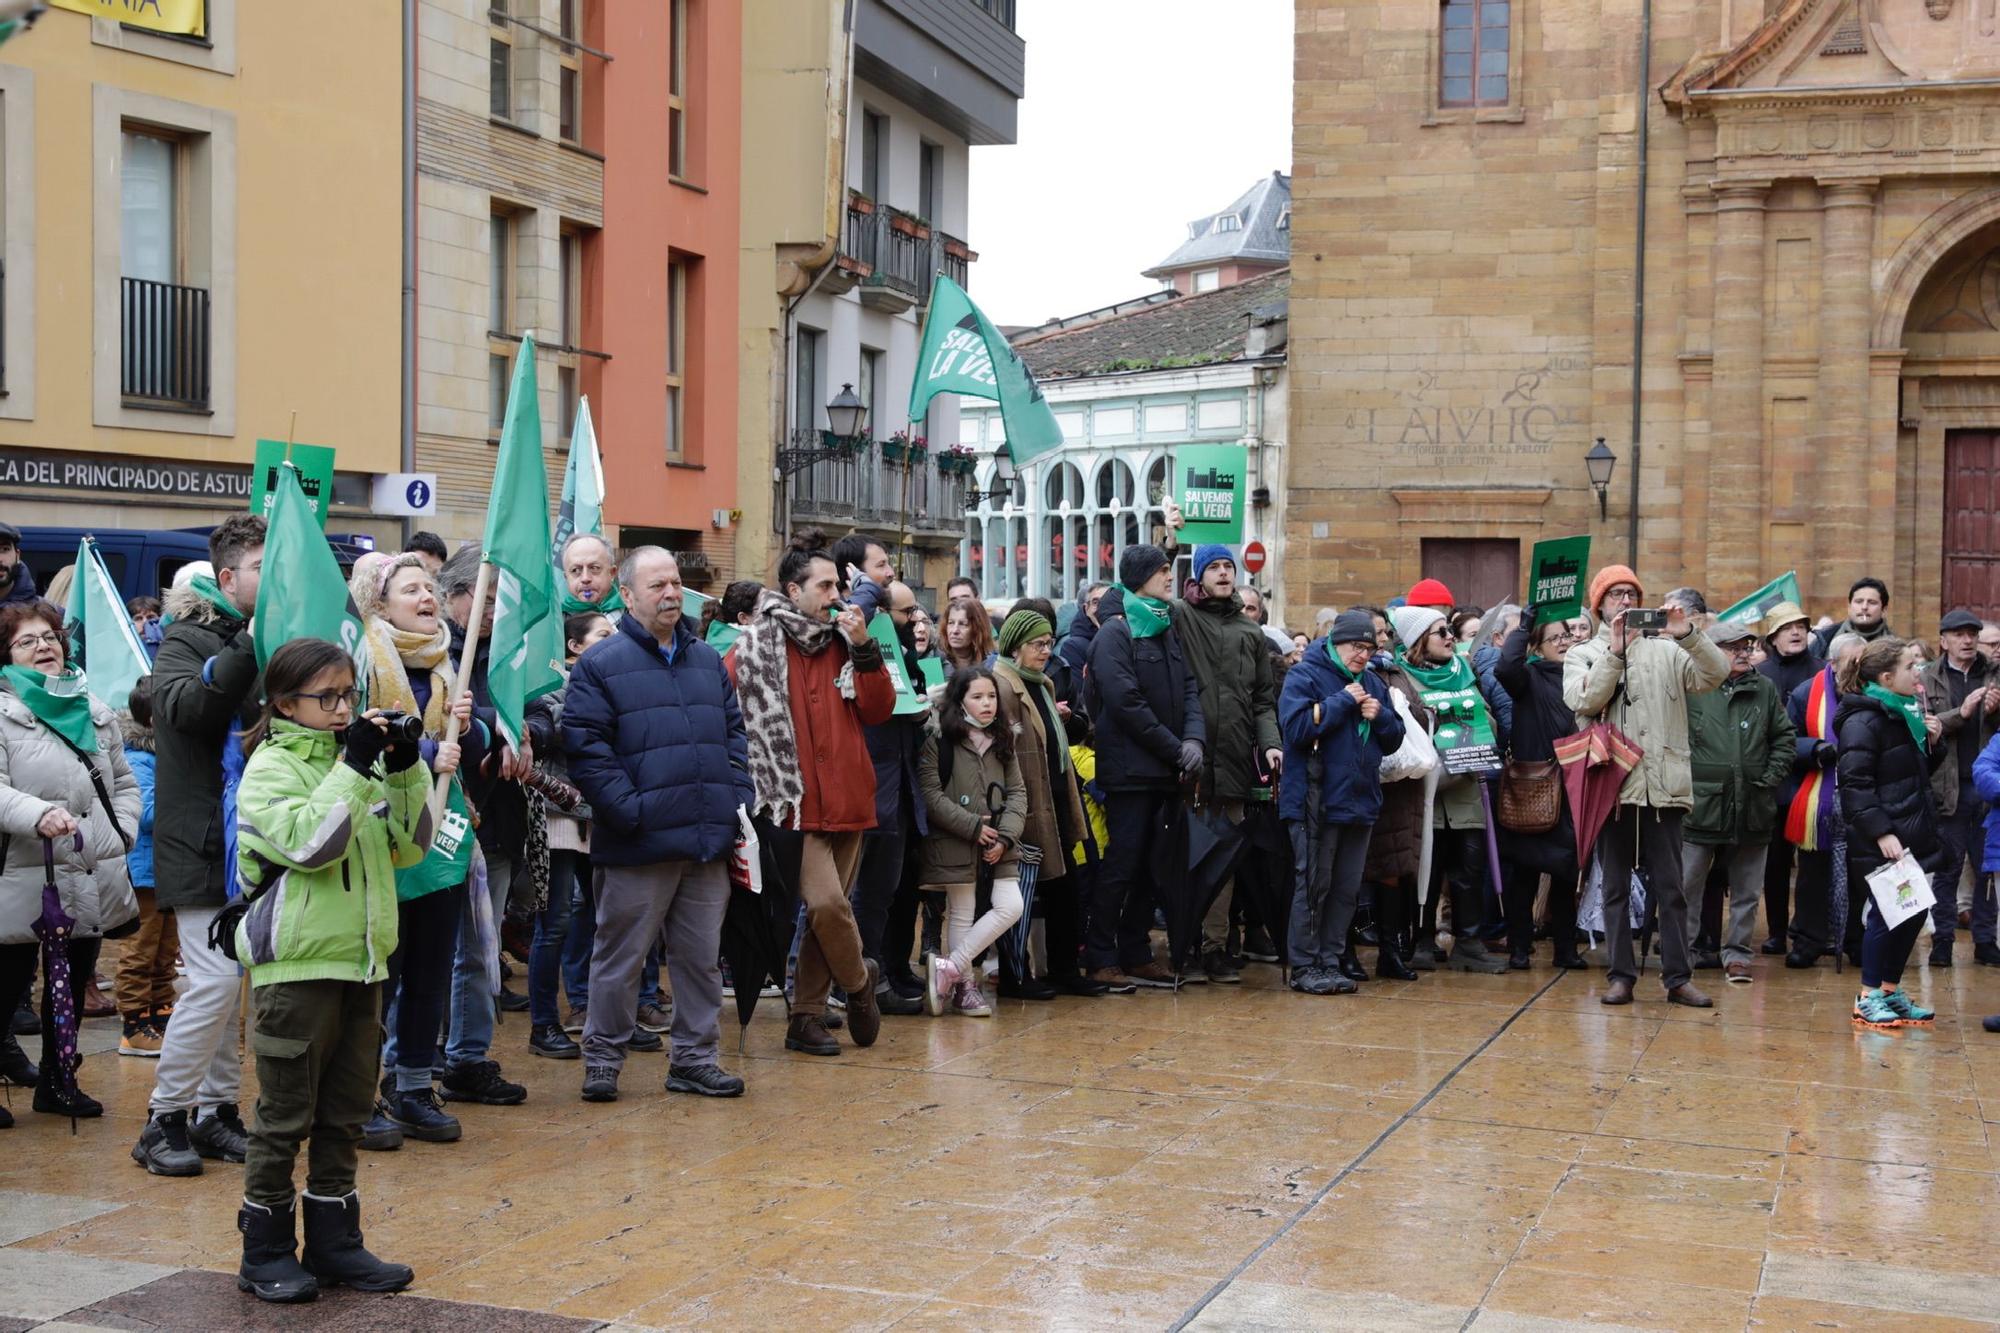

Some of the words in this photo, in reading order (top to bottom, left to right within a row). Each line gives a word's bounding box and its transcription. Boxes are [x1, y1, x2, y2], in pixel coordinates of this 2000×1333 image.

[24, 461, 60, 484] DEL
[65, 464, 174, 491] PRINCIPADO
[177, 471, 200, 491] DE
[1185, 490, 1234, 504] SALVEMOS
[1185, 503, 1199, 518] LA
[1203, 503, 1232, 519] VEGA
[1537, 575, 1577, 590] SALVEMOS
[1536, 589, 1548, 602] LA
[1551, 585, 1575, 600] VEGA
